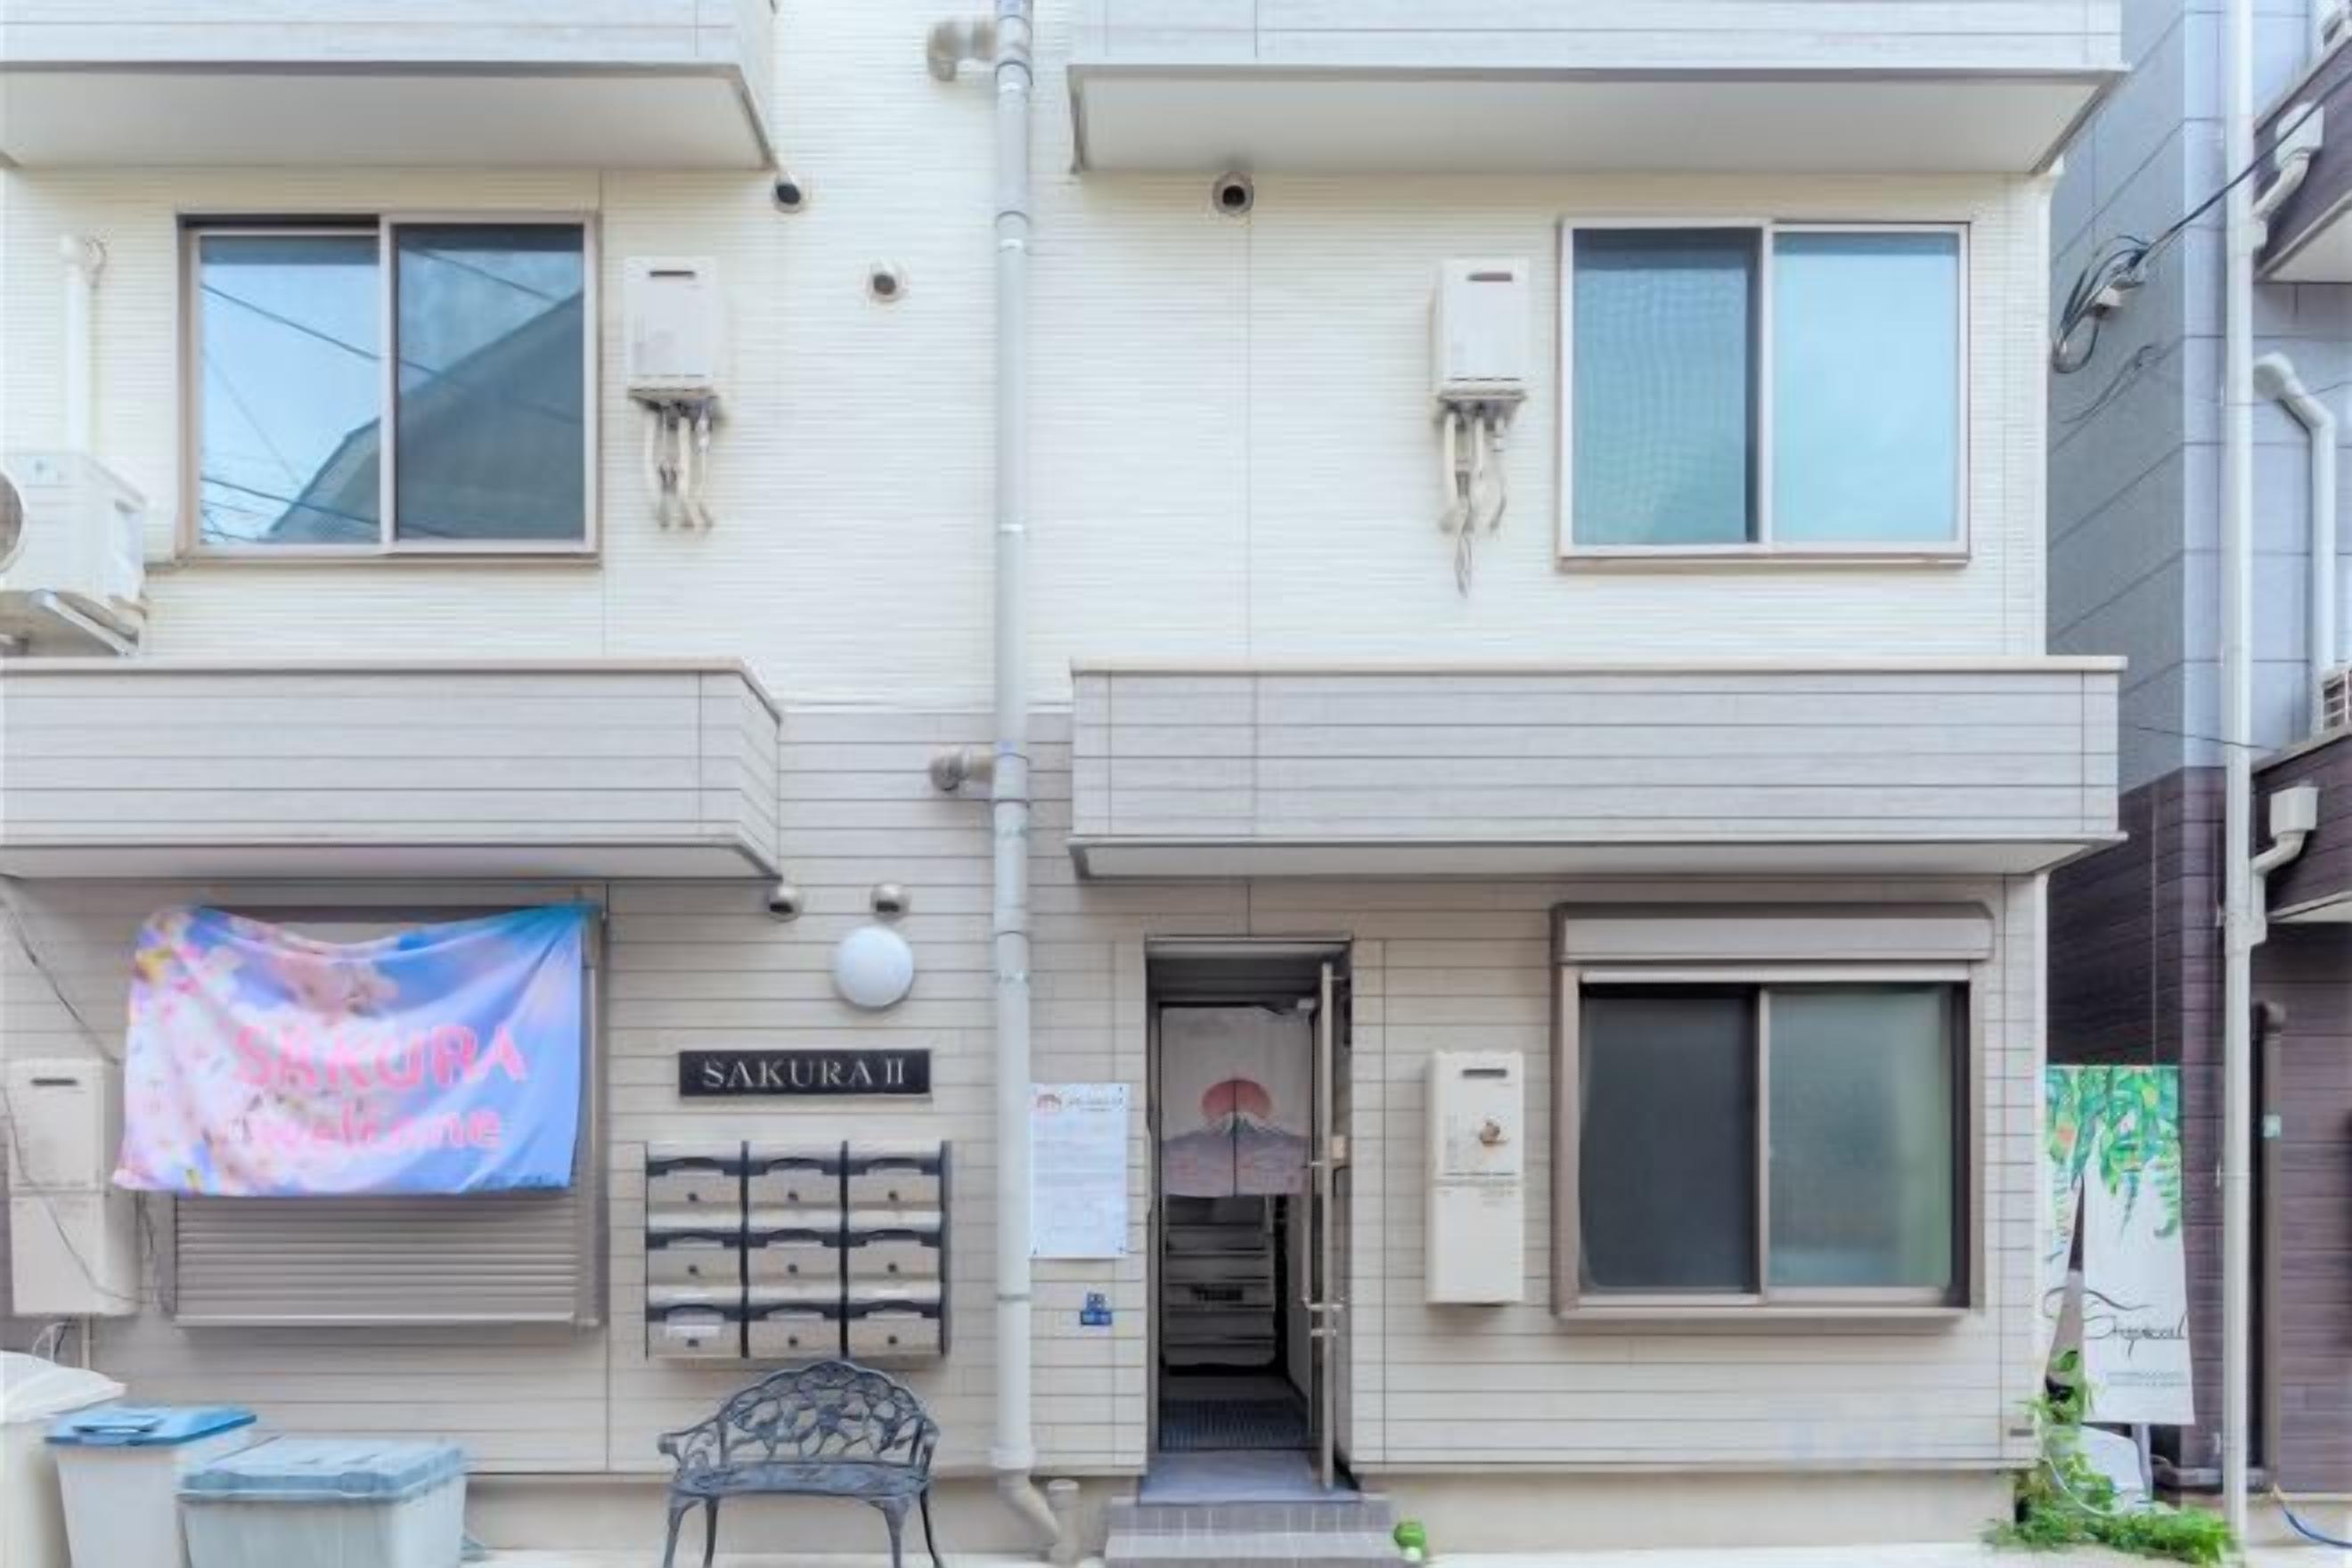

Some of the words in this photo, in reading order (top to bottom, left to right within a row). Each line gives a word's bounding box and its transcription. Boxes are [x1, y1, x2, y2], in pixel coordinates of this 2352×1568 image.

[234, 1023, 527, 1090] SAKURA
[702, 1059, 873, 1089] SAKURA
[886, 1058, 905, 1085] II
